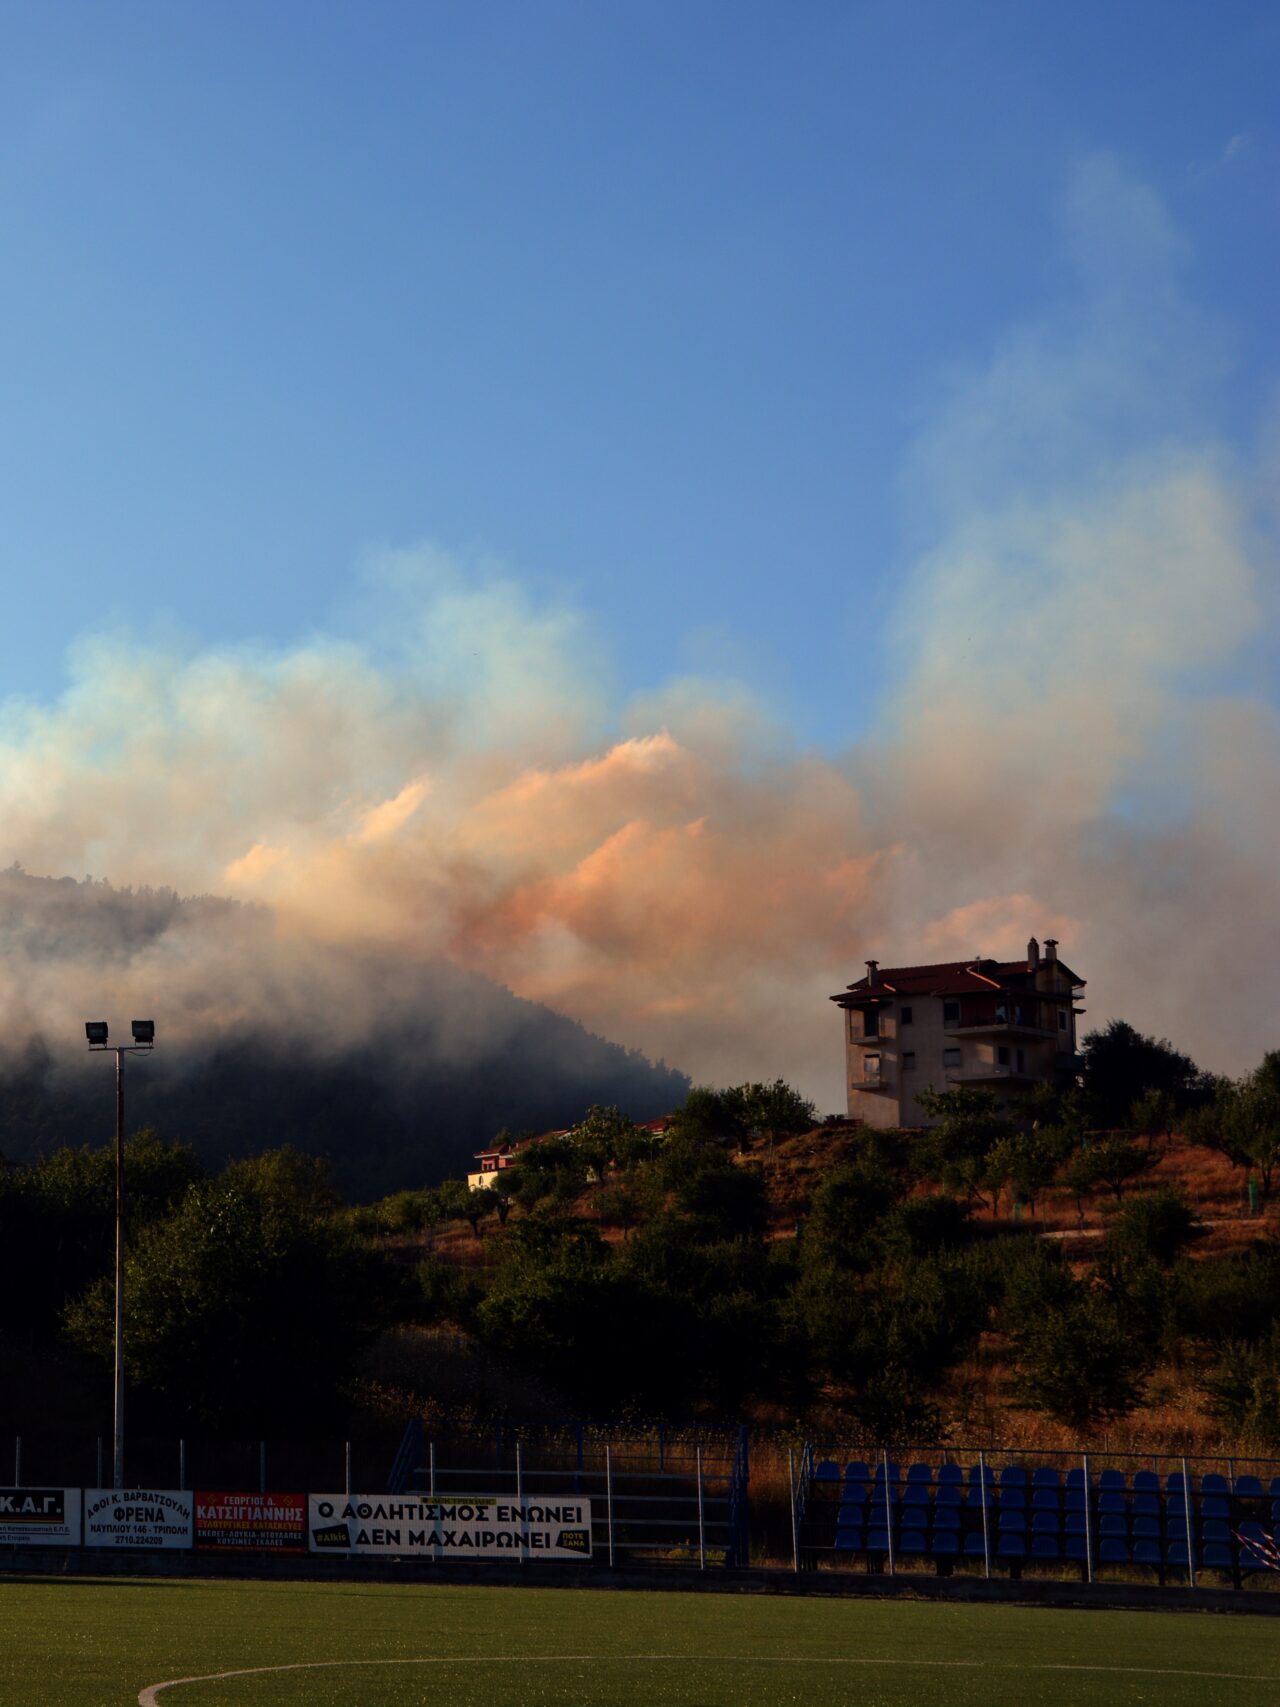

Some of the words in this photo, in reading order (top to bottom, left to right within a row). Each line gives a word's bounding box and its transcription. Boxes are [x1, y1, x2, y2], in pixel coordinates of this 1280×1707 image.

[0, 1496, 62, 1513] Κ.Α.Γ.
[111, 1494, 121, 1504] Κ.
[123, 1492, 190, 1520] ΒΑΡΒΑΤΣΟΥΛΗ
[318, 1502, 334, 1518] Ο
[341, 1503, 489, 1521] ΑΘΛΗΤΙΣΜΟΣ
[497, 1506, 582, 1523] ΕΝΩΝΕΙ
[113, 1507, 165, 1523] ΦΡΕΝΑ
[196, 1505, 303, 1521] ΚΑΤΣΙΓΙΑΝΝΗΣ
[90, 1524, 131, 1534] ΝΑΥΠΛΙΟΥ
[153, 1525, 188, 1535] ΤΡΙΠΟΛΗ
[562, 1532, 584, 1540] ΠΟΤΕ
[115, 1535, 163, 1545] 2710.224209
[355, 1529, 401, 1545] ΔΕΝ
[408, 1530, 551, 1549] ΜΑΧΑΙΡΩΝΕΙ
